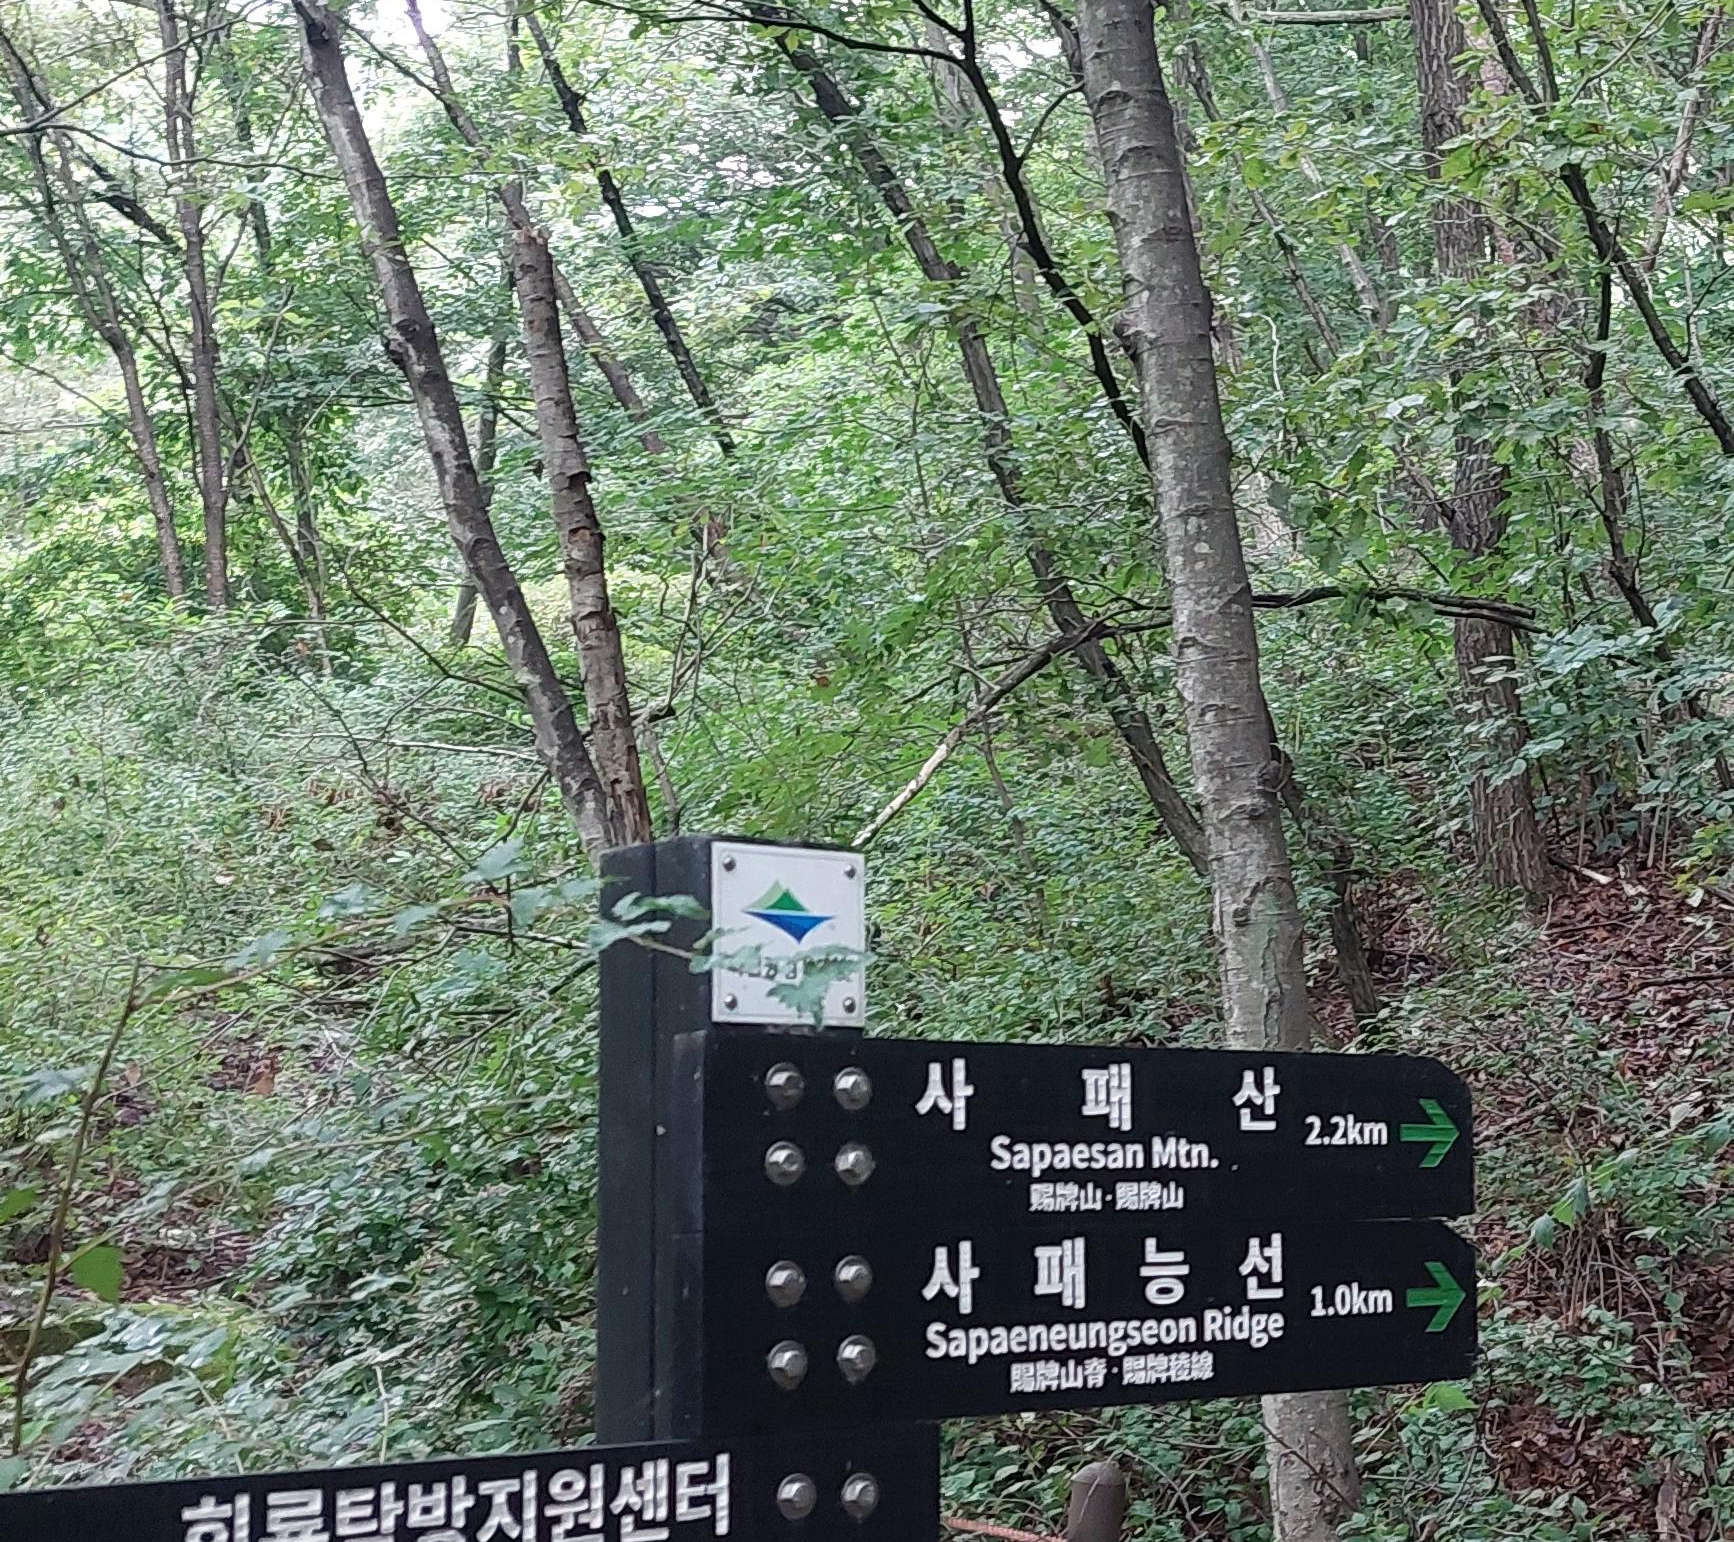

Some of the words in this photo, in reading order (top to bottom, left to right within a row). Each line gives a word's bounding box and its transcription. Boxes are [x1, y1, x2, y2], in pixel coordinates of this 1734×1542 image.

[1304, 1113, 1388, 1146] 2.2km
[990, 1134, 1145, 1178] Sapaesan
[1151, 1135, 1220, 1169] Mtn.
[1310, 1281, 1393, 1318] 1.0km
[925, 1316, 1197, 1365] Sapaeneungseon
[1203, 1305, 1285, 1349] Ridge
